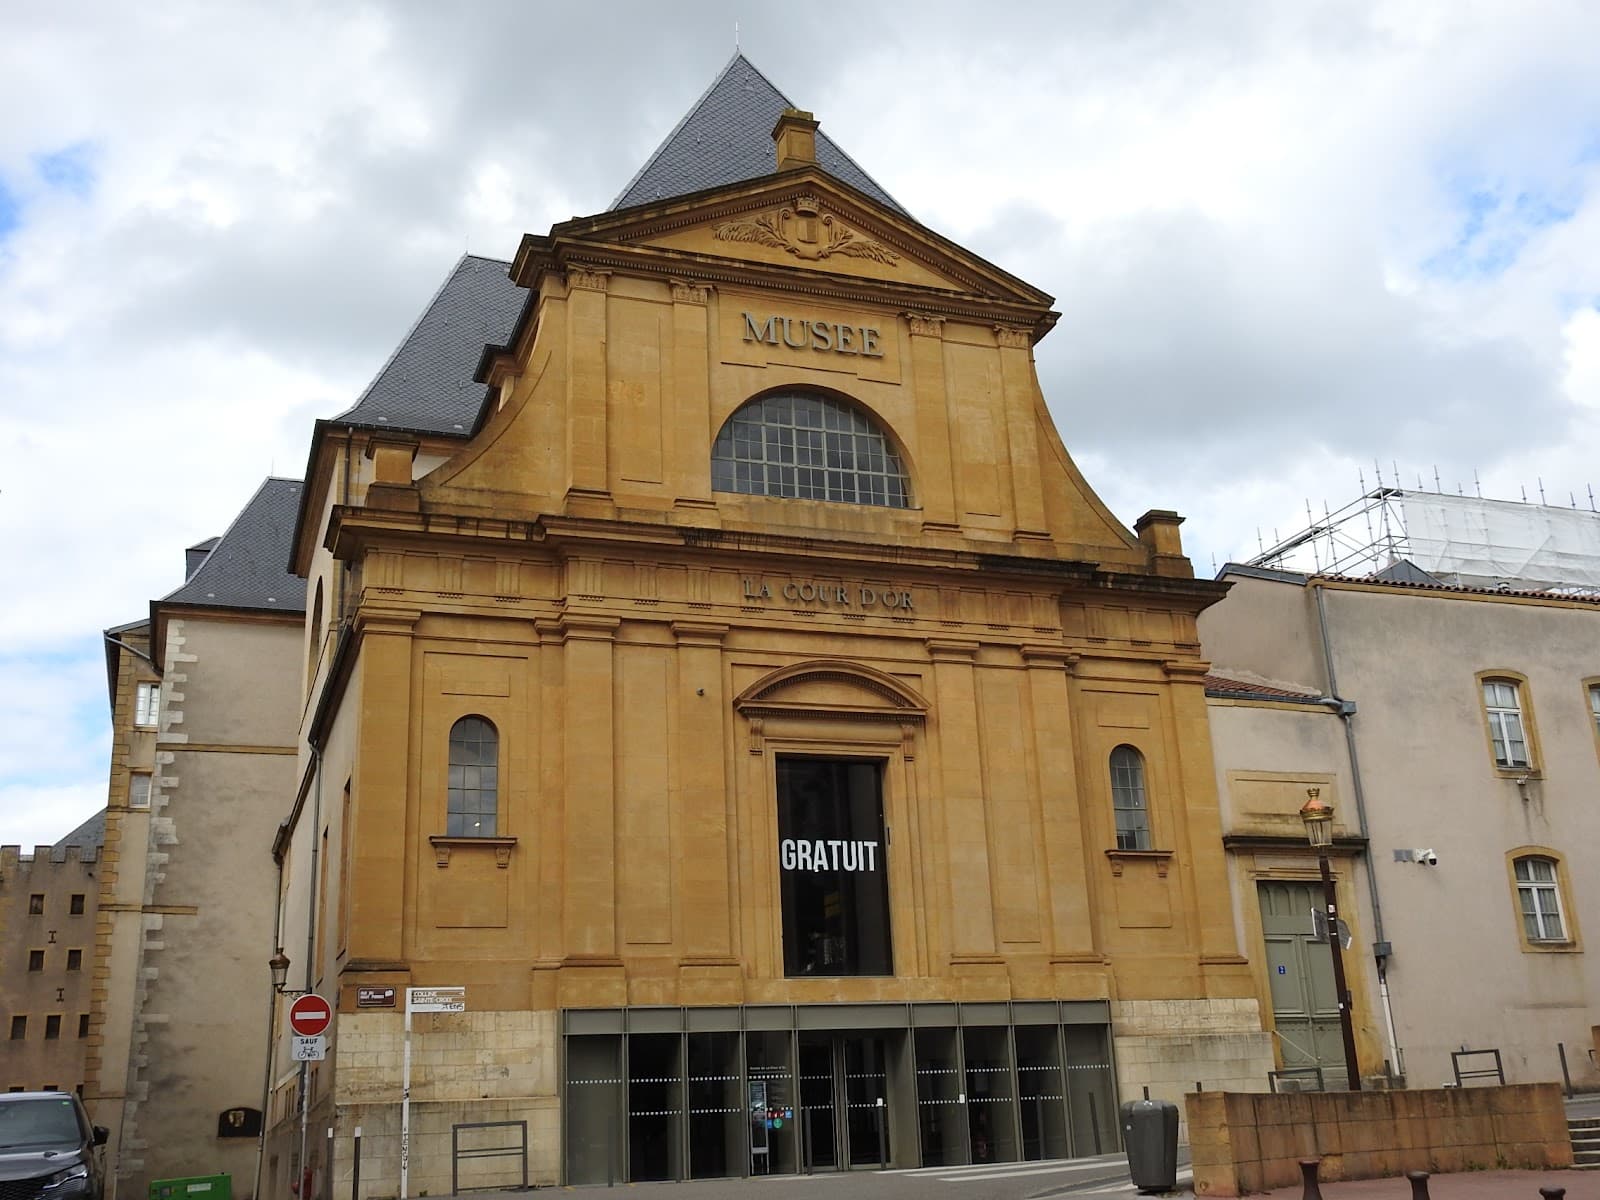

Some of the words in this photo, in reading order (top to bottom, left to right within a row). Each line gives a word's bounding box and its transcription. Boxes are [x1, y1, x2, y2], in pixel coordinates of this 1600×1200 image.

[742, 311, 884, 357] MUSEE
[743, 579, 772, 599] LA
[783, 582, 849, 605] COUR
[781, 839, 878, 872] GRATUIT
[300, 1037, 318, 1045] SAUF
